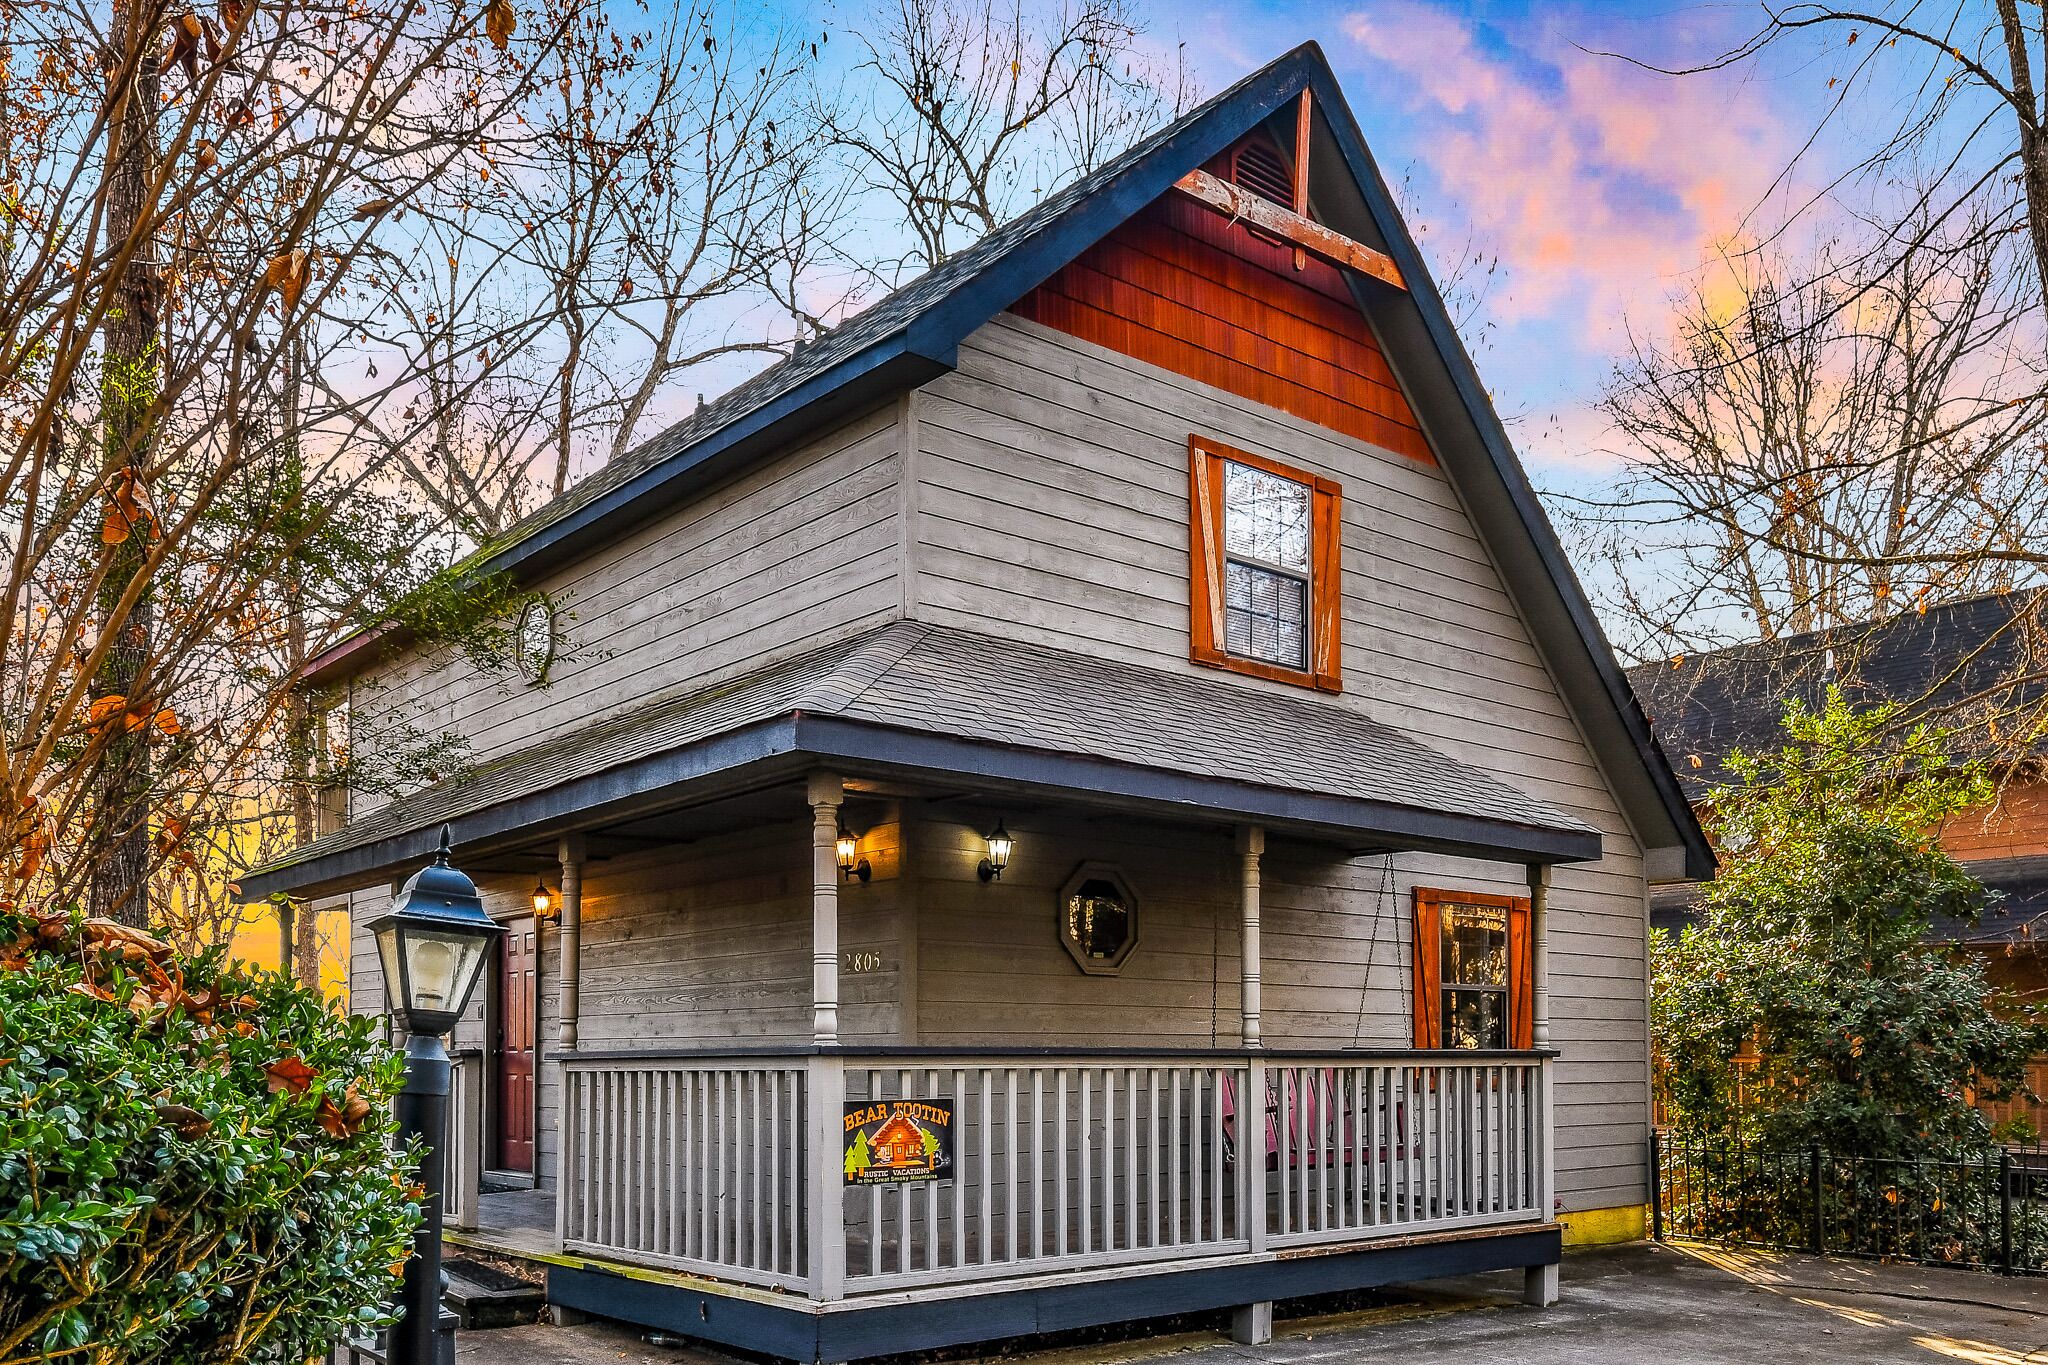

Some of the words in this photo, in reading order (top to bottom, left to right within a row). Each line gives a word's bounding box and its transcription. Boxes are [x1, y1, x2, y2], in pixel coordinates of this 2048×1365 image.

[845, 952, 880, 972] 2805
[844, 1103, 888, 1131] BEAR
[894, 1102, 950, 1126] TOOTIN
[864, 1170, 889, 1178] RUSTIC
